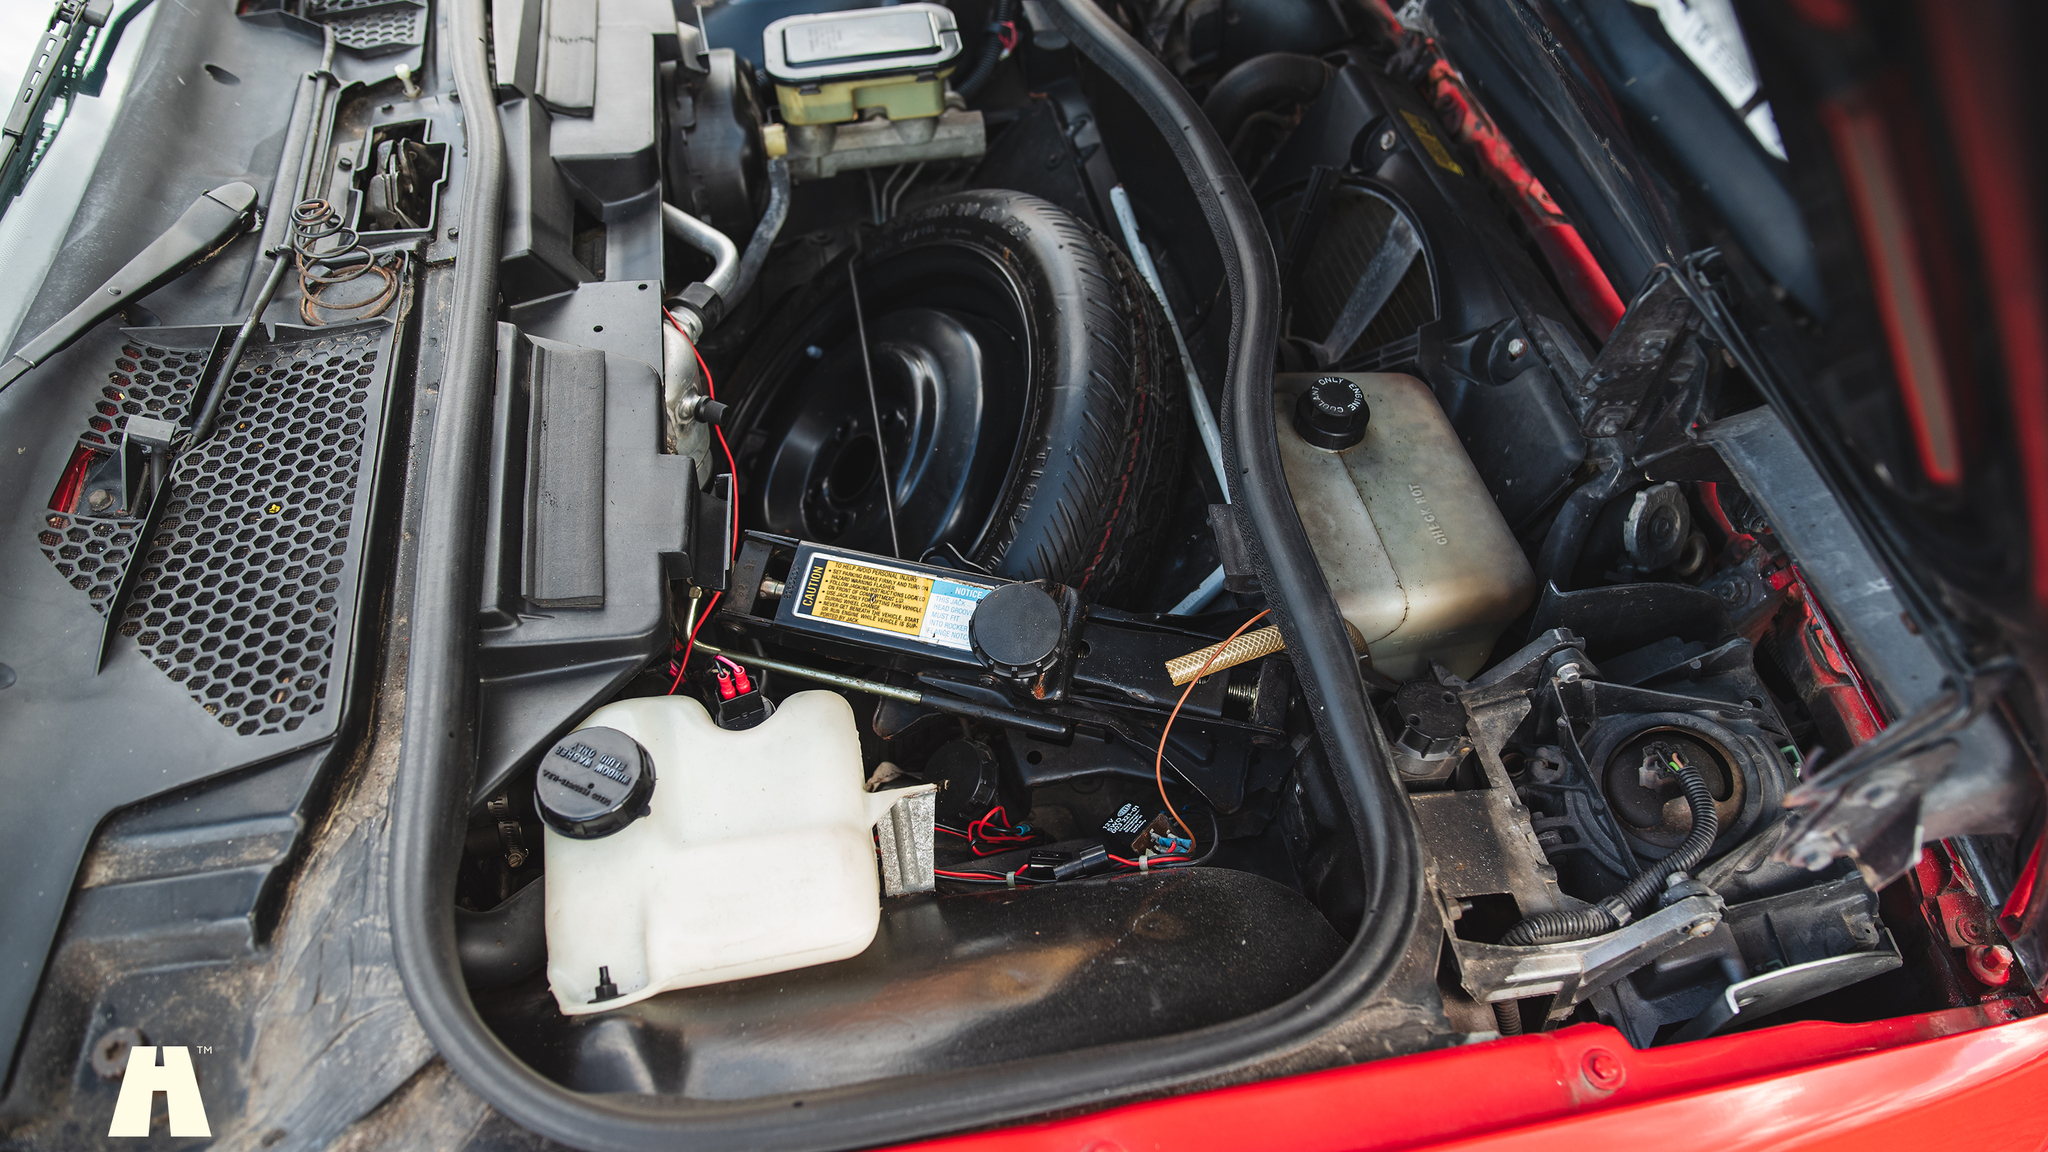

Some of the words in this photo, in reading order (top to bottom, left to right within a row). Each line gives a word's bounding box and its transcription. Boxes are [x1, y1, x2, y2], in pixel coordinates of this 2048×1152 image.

[1311, 385, 1344, 413] COOLANT
[1318, 377, 1344, 386] ONLY
[1348, 383, 1363, 412] ENGINE
[1408, 484, 1427, 504] HOT
[1420, 508, 1448, 545] CHECK
[841, 563, 856, 571] HELP
[855, 566, 871, 574] AVOID
[871, 569, 898, 579] PERSONAL
[841, 570, 862, 579] PARKING
[862, 574, 878, 582] BRAKE
[878, 577, 896, 585] FIRMLY
[802, 565, 824, 607] CAUTION
[830, 573, 850, 582] HAZARD
[850, 577, 873, 586] WARNING
[828, 578, 848, 587] FOLLOW
[848, 582, 869, 591] JACKING
[869, 586, 904, 598] INSTRUCTIONS
[835, 585, 851, 593] FRONT
[954, 586, 983, 599] NOTICE
[824, 594, 843, 603] DURING
[842, 598, 860, 606] WHEEL
[835, 591, 849, 599] JACK
[870, 598, 890, 607] IFTING
[890, 601, 902, 609] THIS
[901, 603, 922, 613] VEHICLE
[932, 602, 950, 612] HEAD
[935, 595, 950, 603] THIS
[949, 597, 966, 607] JACK
[819, 610, 838, 619] PORTED
[822, 600, 839, 608] NEVER
[849, 605, 870, 614] BENEATH
[903, 615, 919, 623] START
[841, 609, 859, 618] ENGINE
[859, 613, 876, 621] WHILE
[876, 616, 898, 625] VEHICLE
[930, 611, 949, 620] MUST
[949, 614, 960, 622] FIT
[926, 626, 950, 637] FLANGE
[928, 618, 943, 627] INTO
[943, 621, 968, 632] ROCKER
[555, 746, 593, 769] WASHER
[571, 742, 597, 758] ONLY
[600, 753, 628, 772] FLUID
[594, 764, 632, 786] WINDOW
[1102, 818, 1114, 829] 12V
